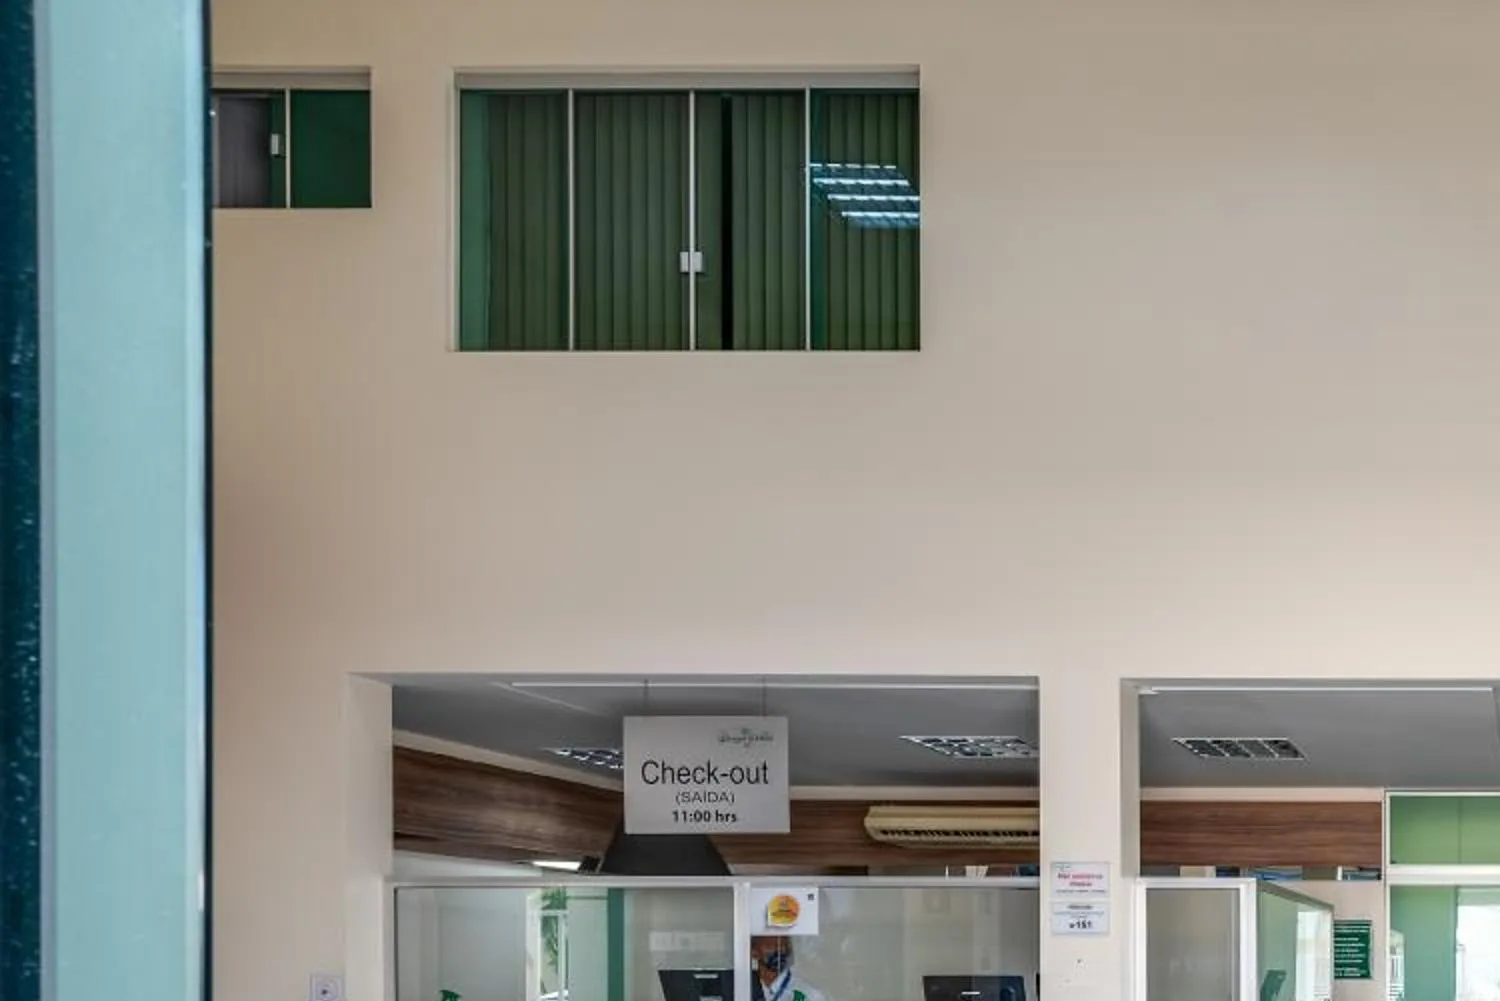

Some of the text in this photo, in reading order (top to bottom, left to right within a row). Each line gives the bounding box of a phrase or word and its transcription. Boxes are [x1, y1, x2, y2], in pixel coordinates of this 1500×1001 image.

[640, 759, 769, 785] Check-out
[672, 809, 737, 823] 11:00 hrs
